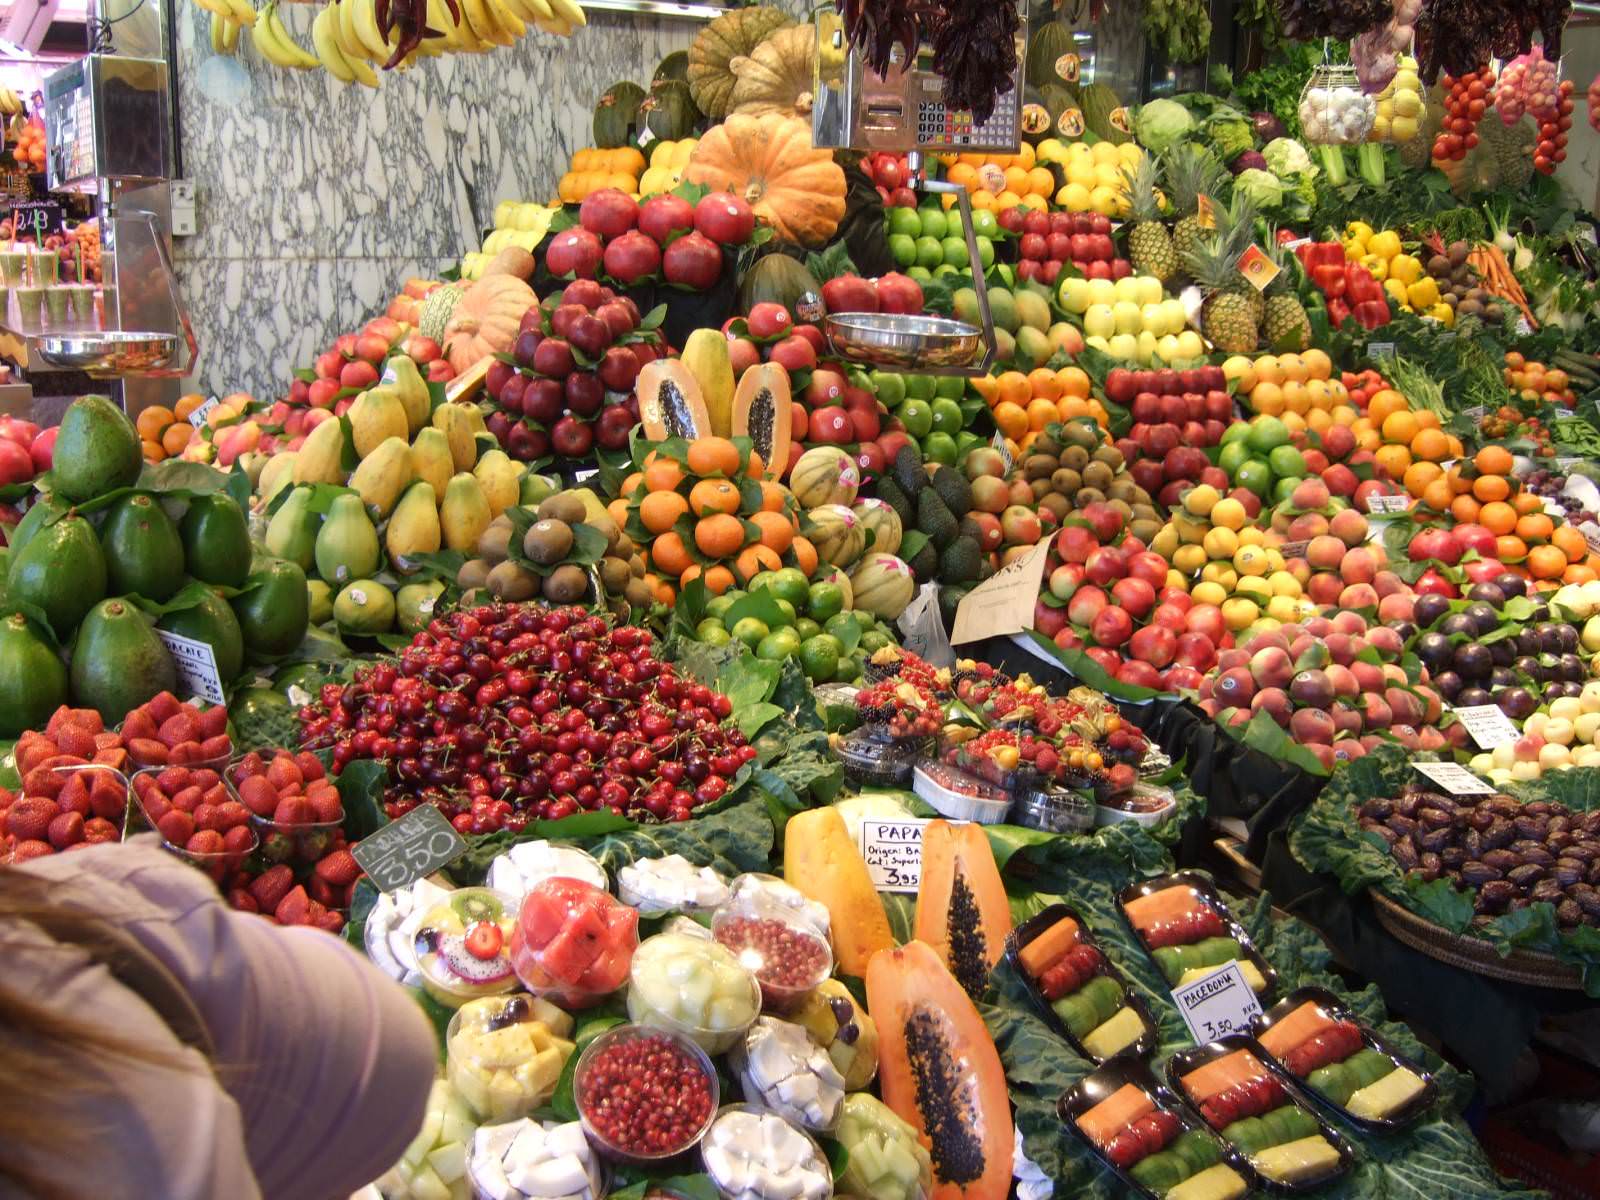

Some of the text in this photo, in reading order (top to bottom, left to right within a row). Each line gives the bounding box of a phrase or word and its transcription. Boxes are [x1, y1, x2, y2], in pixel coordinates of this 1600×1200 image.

[878, 825, 922, 840] PAPA
[374, 831, 457, 889] 3,50
[868, 845, 901, 858] Origen:
[1183, 973, 1233, 1007] MACEDONIA
[1202, 1019, 1232, 1040] 3,50
